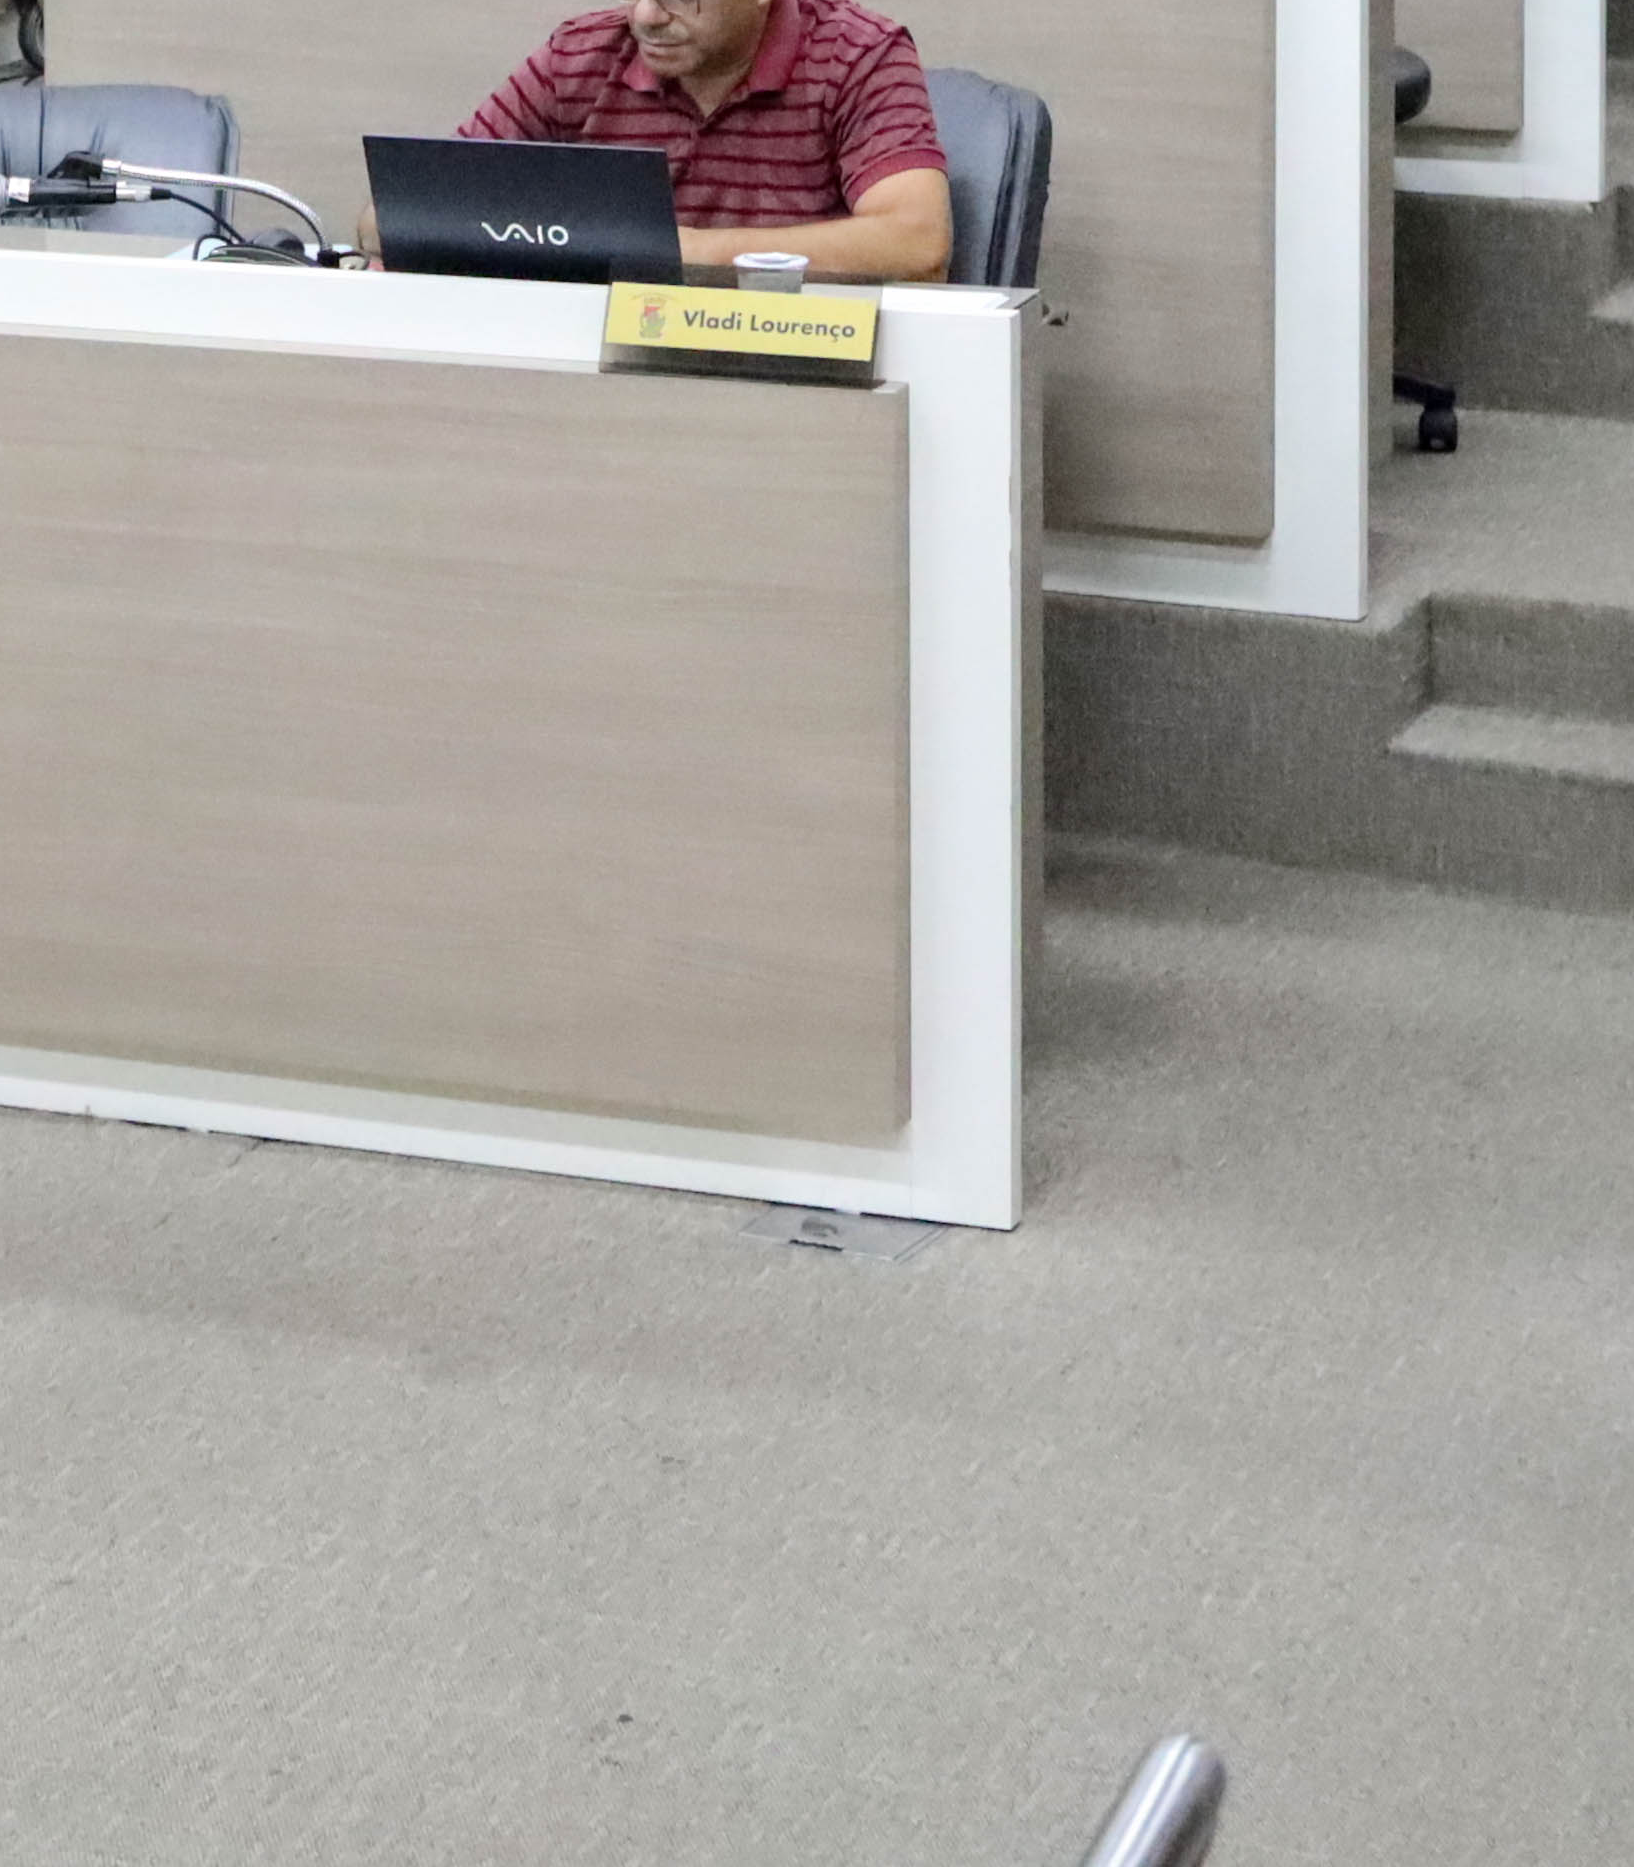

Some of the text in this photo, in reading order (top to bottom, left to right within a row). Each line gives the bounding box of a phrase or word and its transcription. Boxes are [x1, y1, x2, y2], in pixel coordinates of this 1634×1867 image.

[481, 222, 569, 246] VAIO
[683, 309, 856, 342] Vladi Lourenço
